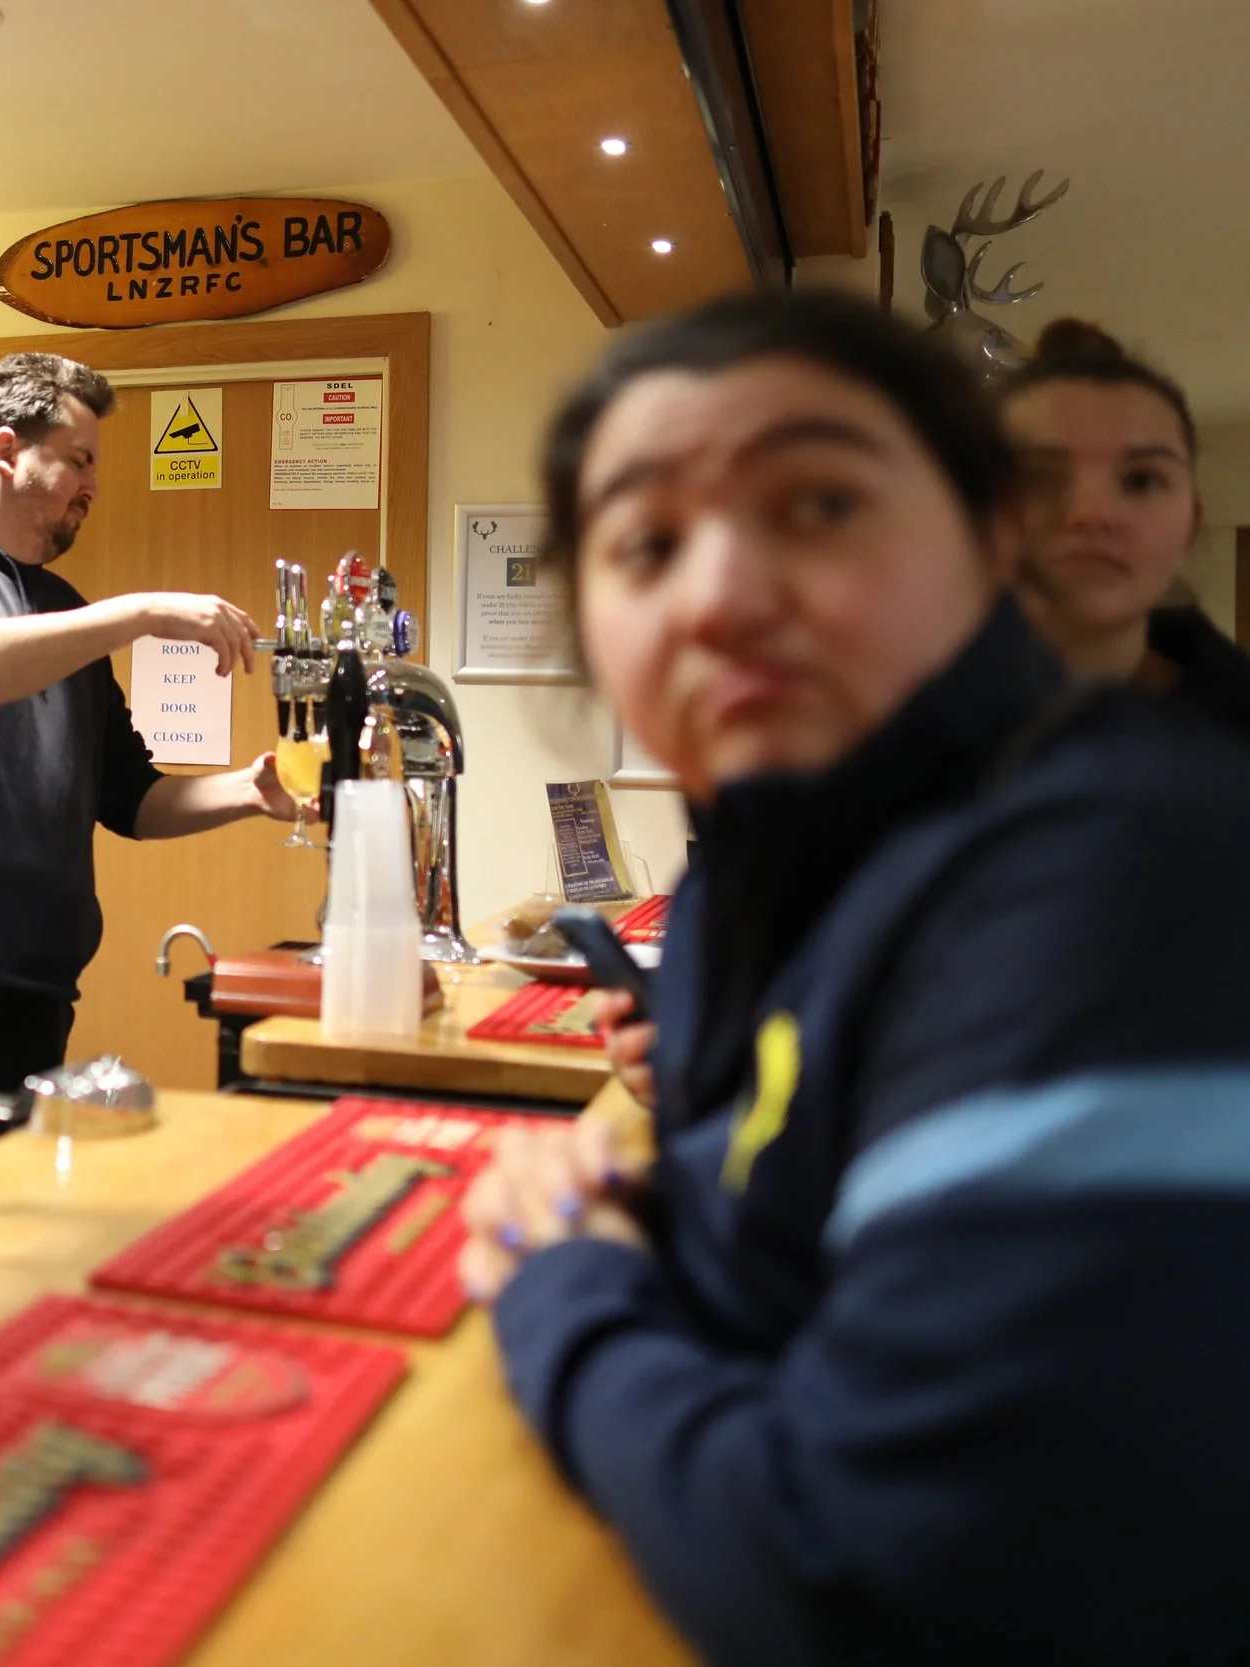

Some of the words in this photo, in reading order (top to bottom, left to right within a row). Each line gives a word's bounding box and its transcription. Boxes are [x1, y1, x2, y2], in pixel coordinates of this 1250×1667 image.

[30, 214, 265, 280] SPORTSMAN'S
[283, 211, 363, 258] BAR
[107, 271, 242, 301] LNZRFC
[326, 382, 354, 390] SDEL
[328, 394, 351, 402] CAUTION
[323, 415, 354, 424] IMPORTANT
[169, 459, 203, 472] CCTV
[156, 472, 166, 482] in
[168, 470, 216, 482] operation
[511, 564, 532, 582] 21
[161, 644, 200, 655] ROOM
[163, 674, 196, 684] KEEP
[161, 703, 197, 713] DOOR
[153, 732, 203, 744] CLOSED
